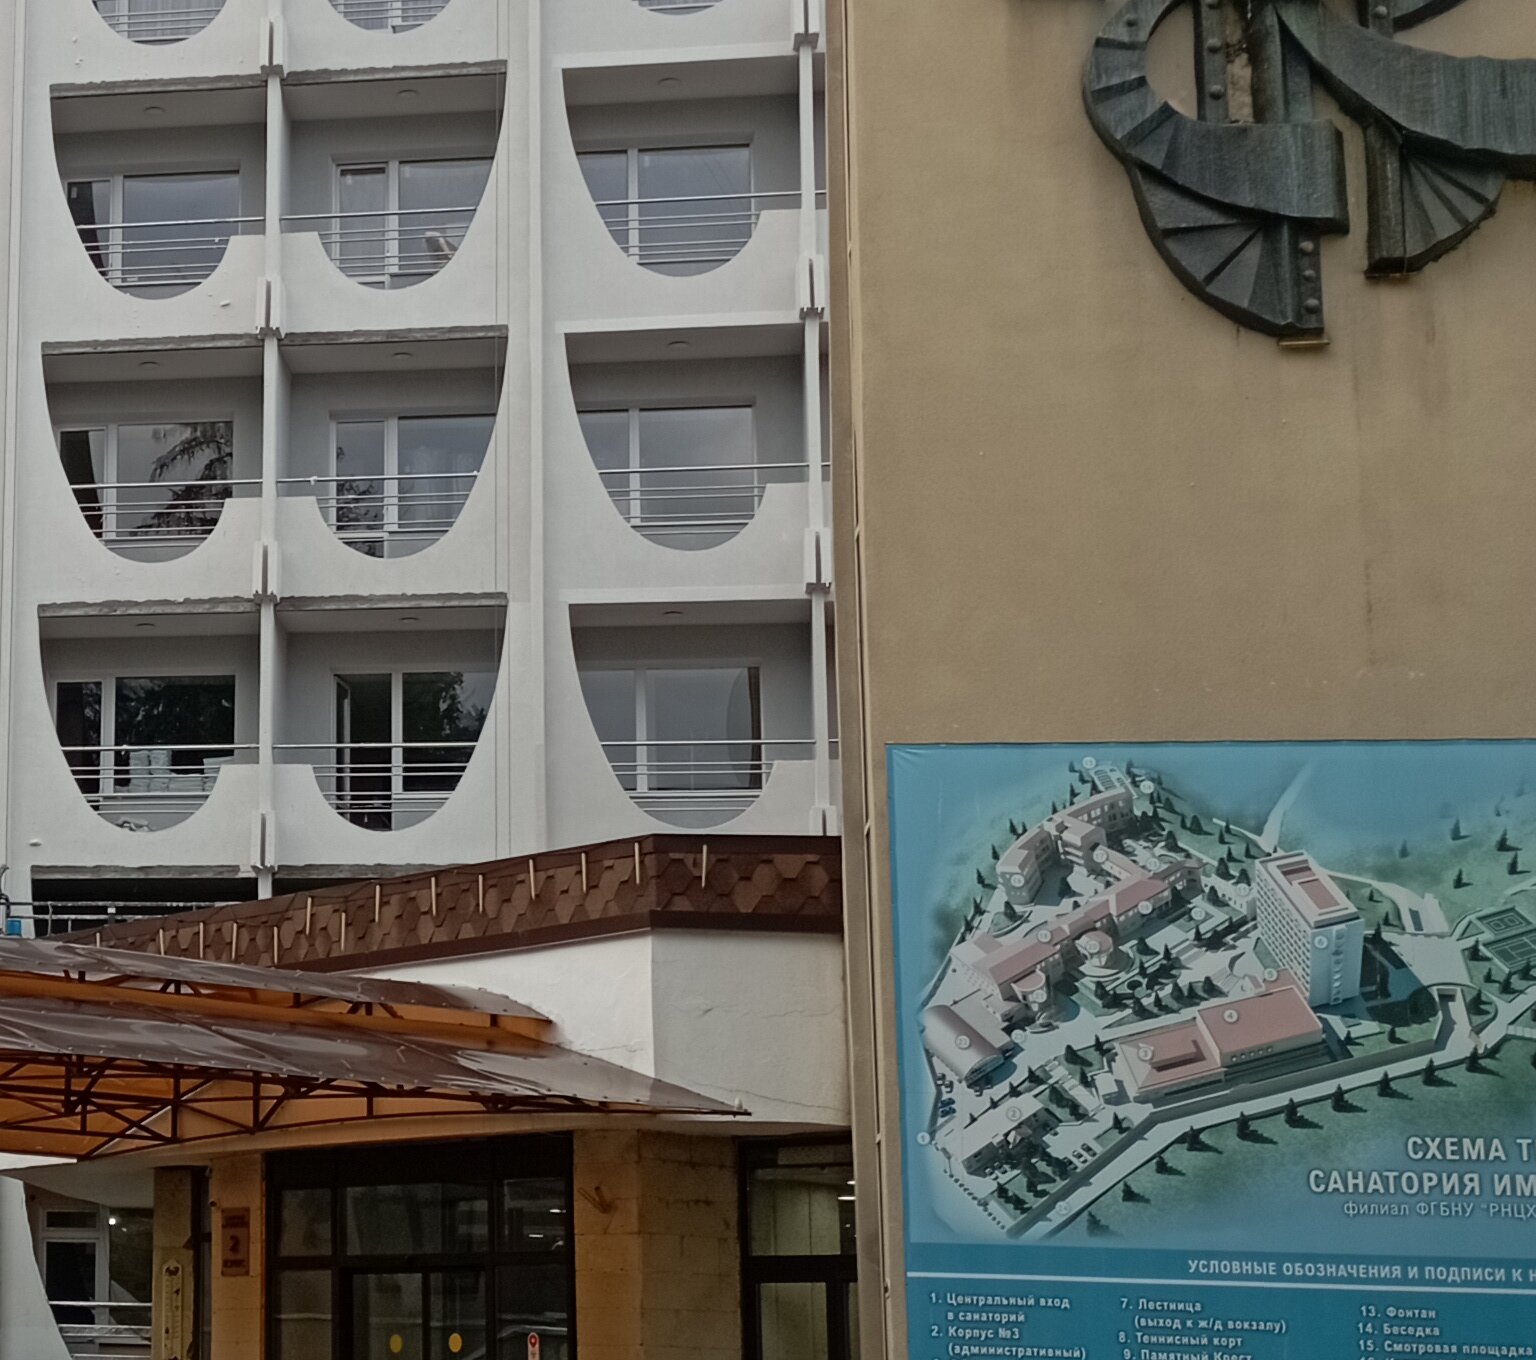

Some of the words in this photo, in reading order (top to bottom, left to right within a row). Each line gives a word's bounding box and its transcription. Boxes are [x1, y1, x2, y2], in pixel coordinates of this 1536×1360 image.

[1407, 1137, 1506, 1161] СХЕМА
[1516, 1139, 1536, 1161] Т
[1309, 1170, 1481, 1195] САНАТОРИЯ
[1344, 1202, 1409, 1217] филиал
[1416, 1202, 1473, 1216] ФГБНУ
[1188, 1259, 1277, 1275] УСЛОВНЫЕ
[1283, 1263, 1401, 1278] ОБОЗНАЧЕНИЯ
[1408, 1266, 1419, 1278] И
[1425, 1266, 1505, 1282] ПОДПИСИ
[1512, 1268, 1522, 1282] К
[930, 1293, 942, 1303] 1.
[947, 1293, 1034, 1307] Центральный
[1039, 1297, 1070, 1308] вход
[1121, 1298, 1133, 1309] 7.
[1139, 1299, 1202, 1312] Лестница
[947, 1312, 953, 1320] в
[959, 1311, 1025, 1323] санаторий
[1361, 1306, 1381, 1317] 13.
[1386, 1306, 1436, 1318] Фонтан
[1135, 1315, 1181, 1329] (выход
[1187, 1318, 1193, 1327] к
[931, 1326, 942, 1336] 2.
[948, 1326, 994, 1340] Корпус
[999, 1328, 1019, 1338] №3
[1358, 1323, 1378, 1334] 14.
[1383, 1323, 1440, 1337] Беседка
[1119, 1333, 1130, 1342] 8.
[1136, 1333, 1208, 1345] Теннисный
[1213, 1337, 1242, 1348] корт
[1124, 1349, 1136, 1360] 9.
[1360, 1340, 1379, 1351] 15.
[1384, 1341, 1457, 1354] Смотровая
[1463, 1344, 1533, 1357] площадка
